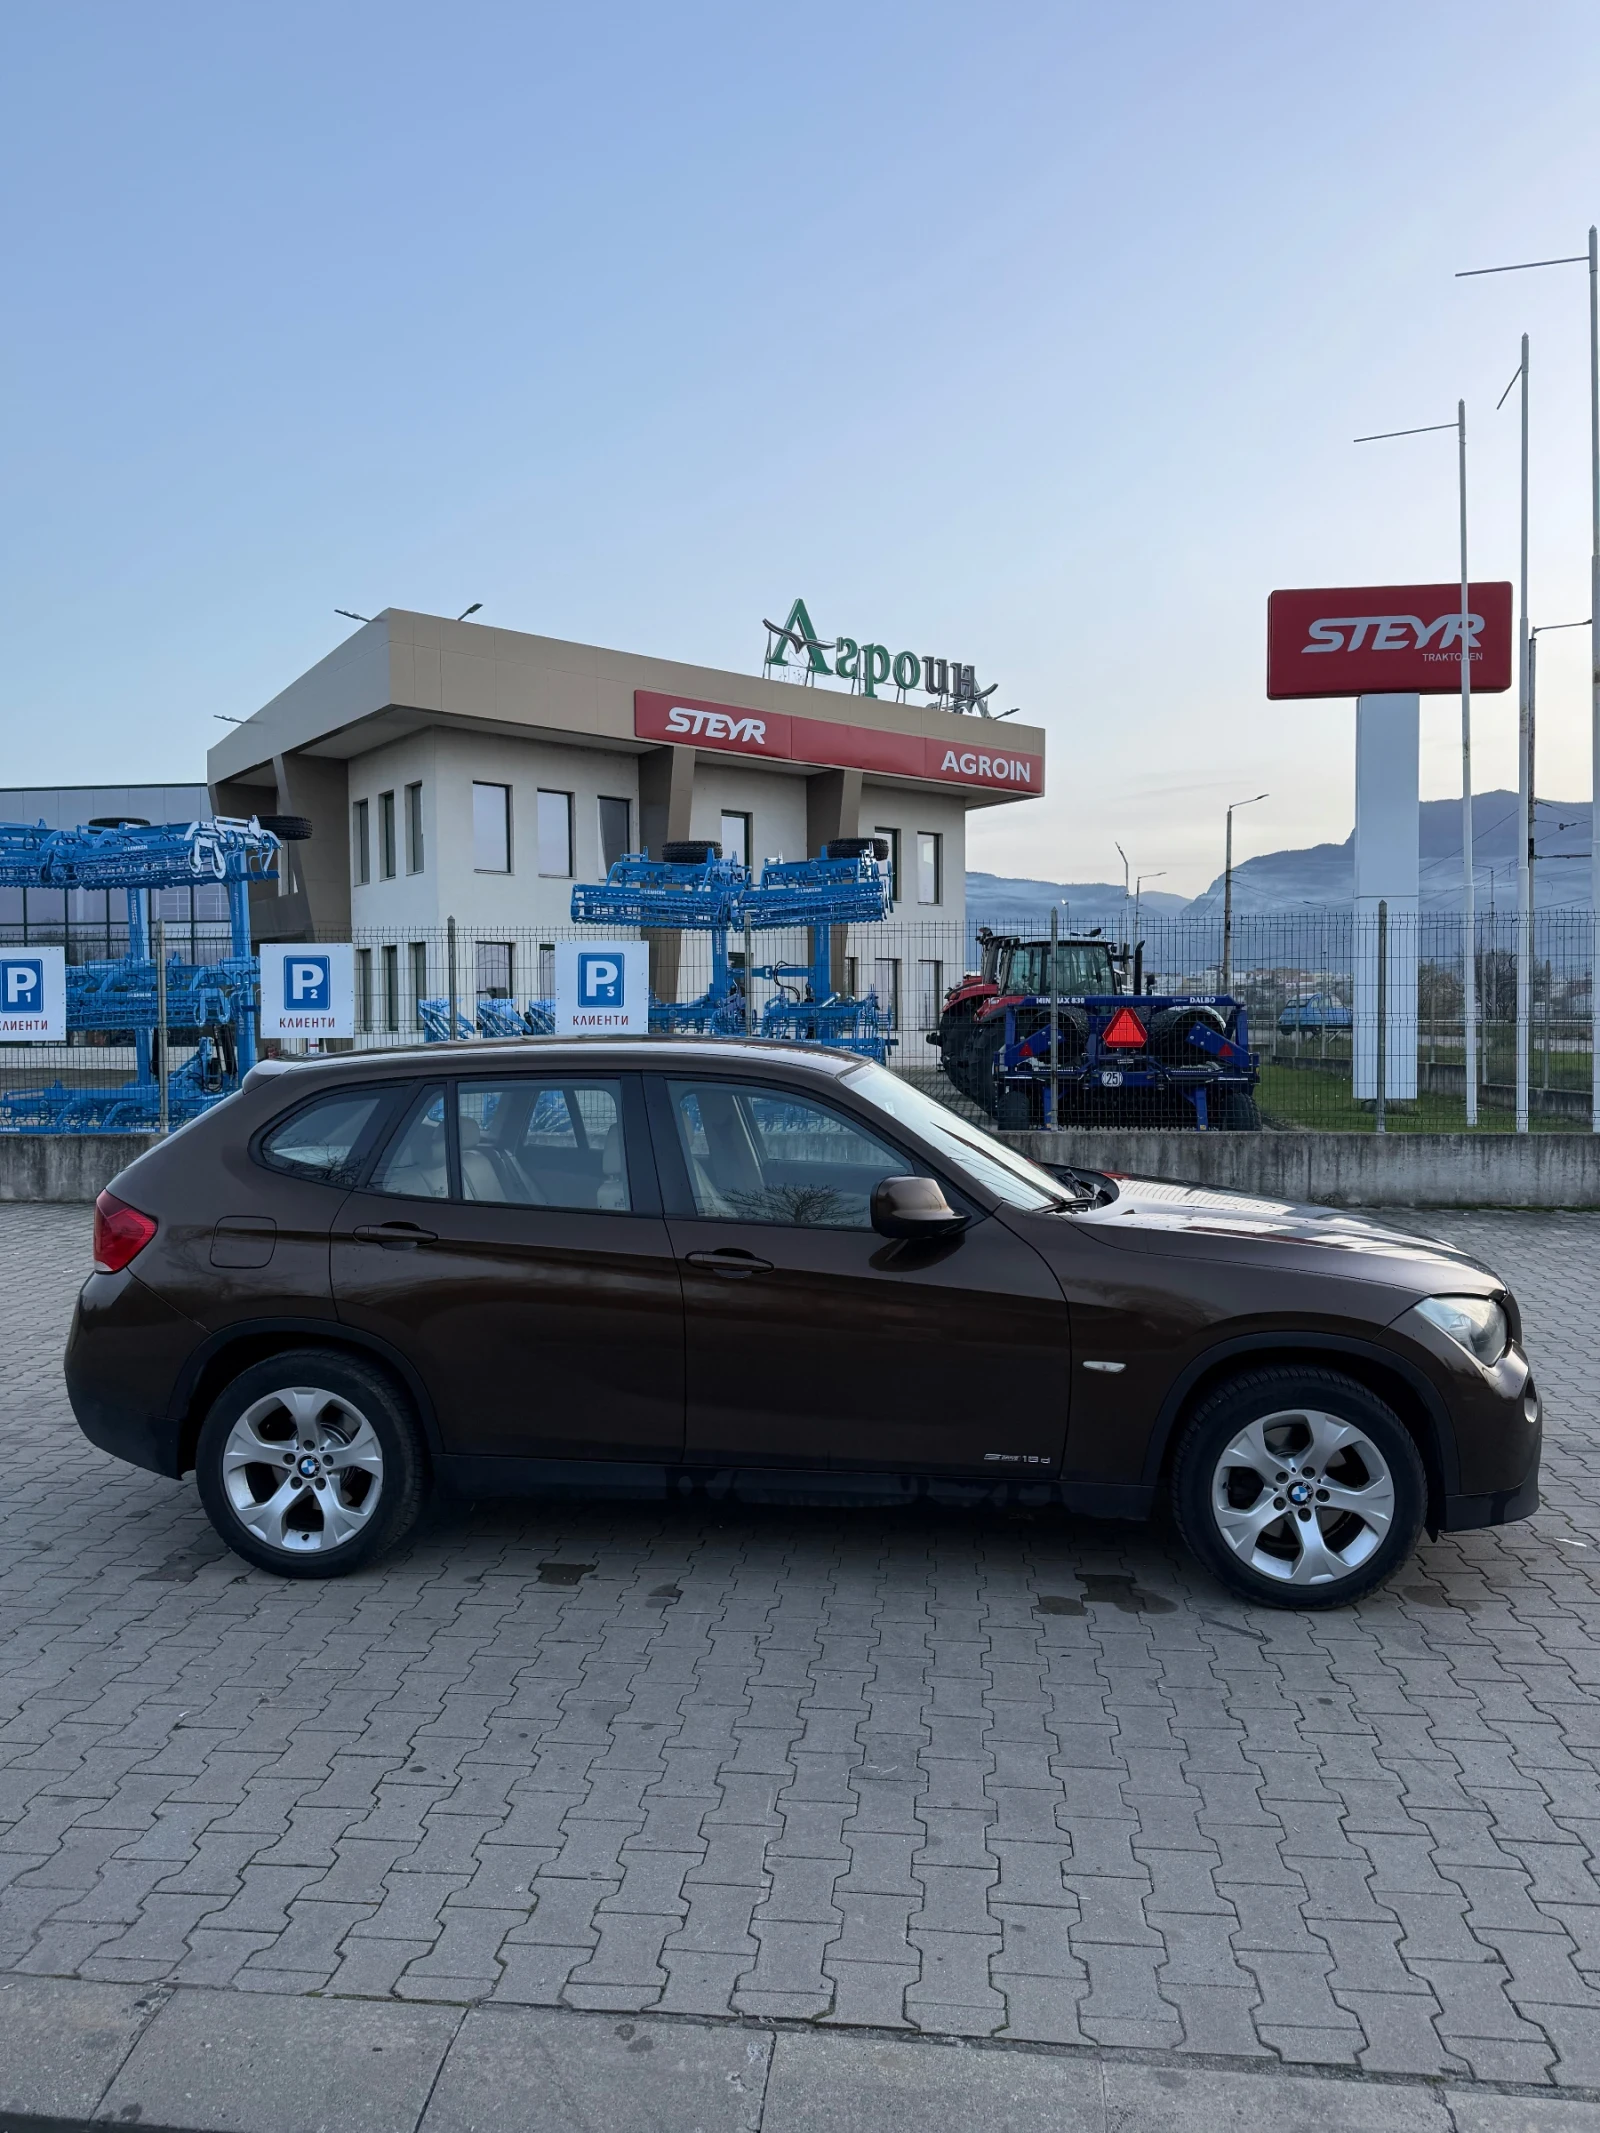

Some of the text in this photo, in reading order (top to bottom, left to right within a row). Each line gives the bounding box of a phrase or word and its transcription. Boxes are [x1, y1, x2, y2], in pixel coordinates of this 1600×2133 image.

[1301, 613, 1486, 654] STEYR
[1422, 652, 1484, 662] TRAKTOEN
[665, 706, 767, 745] STEYR
[940, 750, 1032, 783] AGROIN
[1189, 996, 1216, 1004] DALBO
[0, 1020, 48, 1031] ЛИЕНТИ
[279, 1017, 335, 1029] КЛИЕНТИ
[572, 1015, 629, 1026] КЛИЕНТИ
[1106, 1072, 1119, 1085] 25
